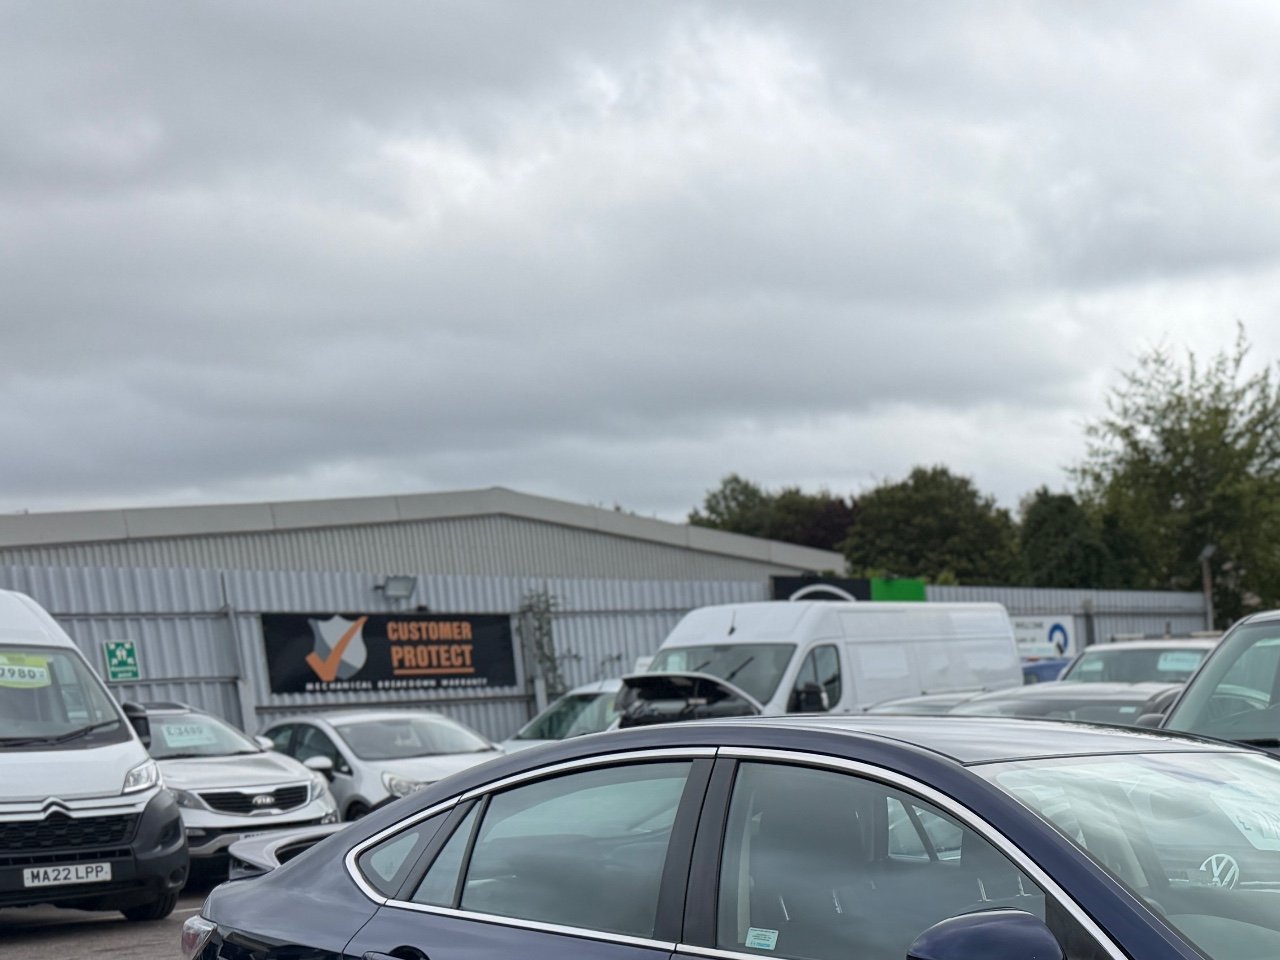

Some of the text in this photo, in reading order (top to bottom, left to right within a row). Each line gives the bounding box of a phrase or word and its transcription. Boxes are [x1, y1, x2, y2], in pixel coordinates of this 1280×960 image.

[387, 621, 472, 641] CUSTOMER
[391, 645, 473, 667] PROTECT
[305, 680, 372, 691] MECHANICAL
[377, 679, 437, 689] BREAKDOWN
[31, 866, 104, 883] MA22 LPP
